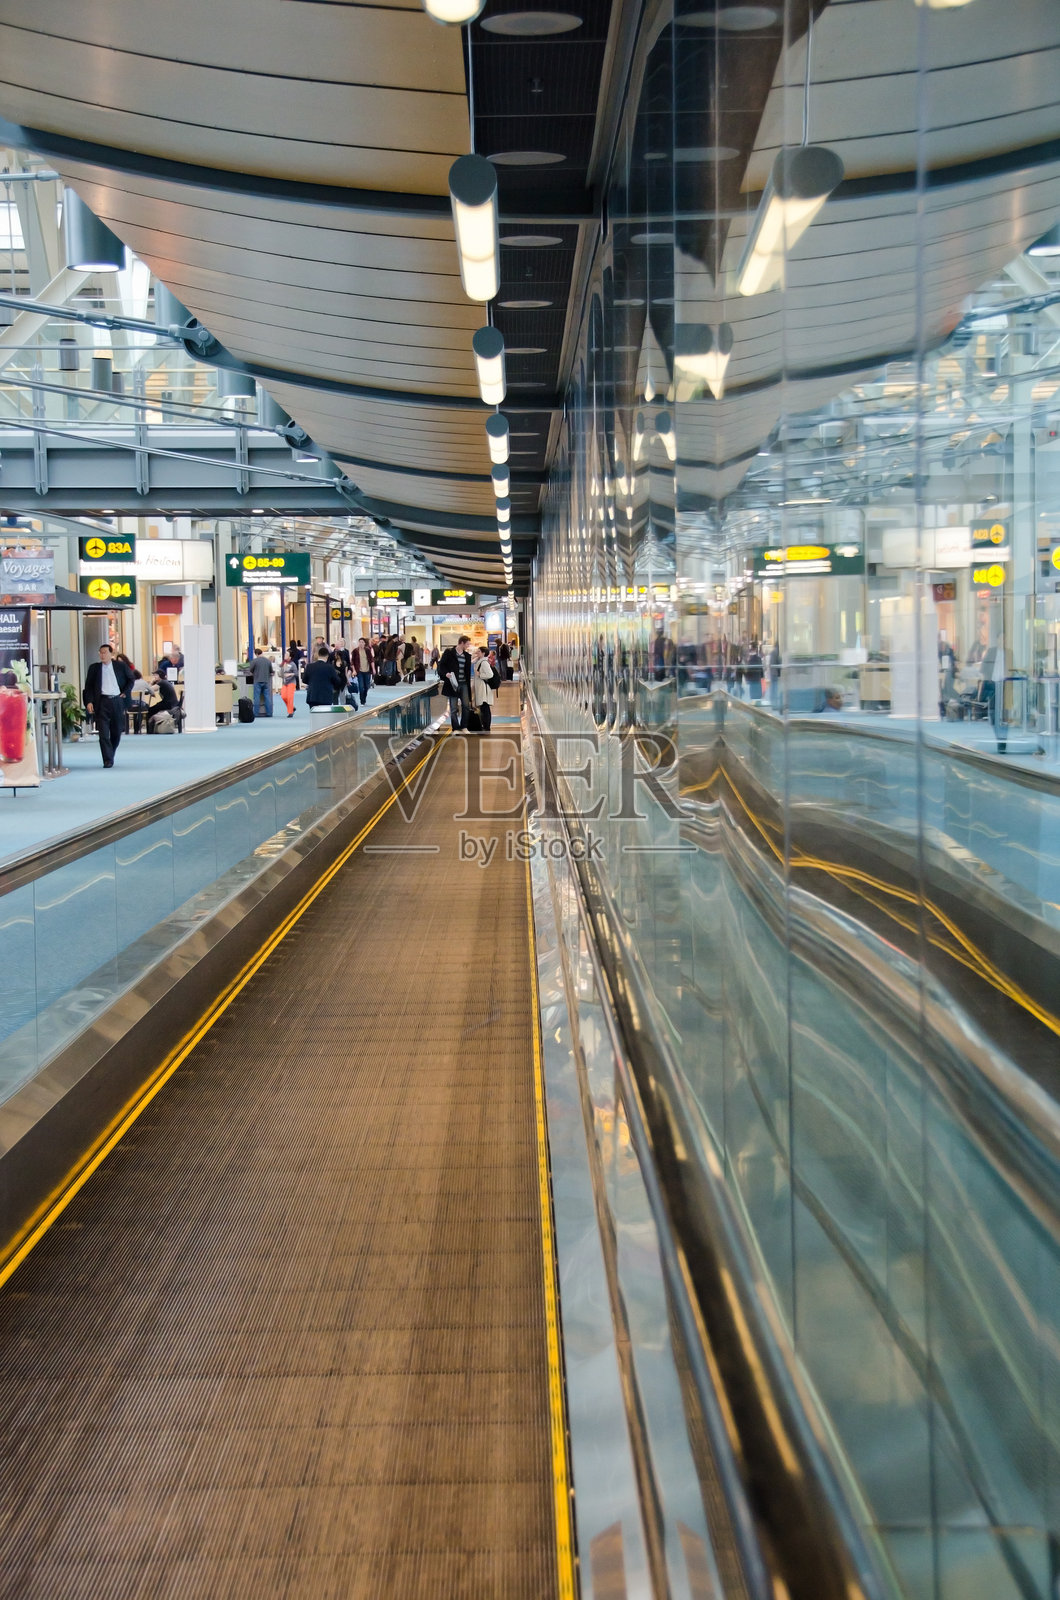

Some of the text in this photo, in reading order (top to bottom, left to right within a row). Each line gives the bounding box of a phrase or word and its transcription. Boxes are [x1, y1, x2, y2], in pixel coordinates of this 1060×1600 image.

[107, 542, 132, 554] 83A
[3, 561, 52, 578] Voyages
[18, 583, 37, 591] BAR
[110, 582, 132, 598] 84
[0, 624, 22, 633] aesar!
